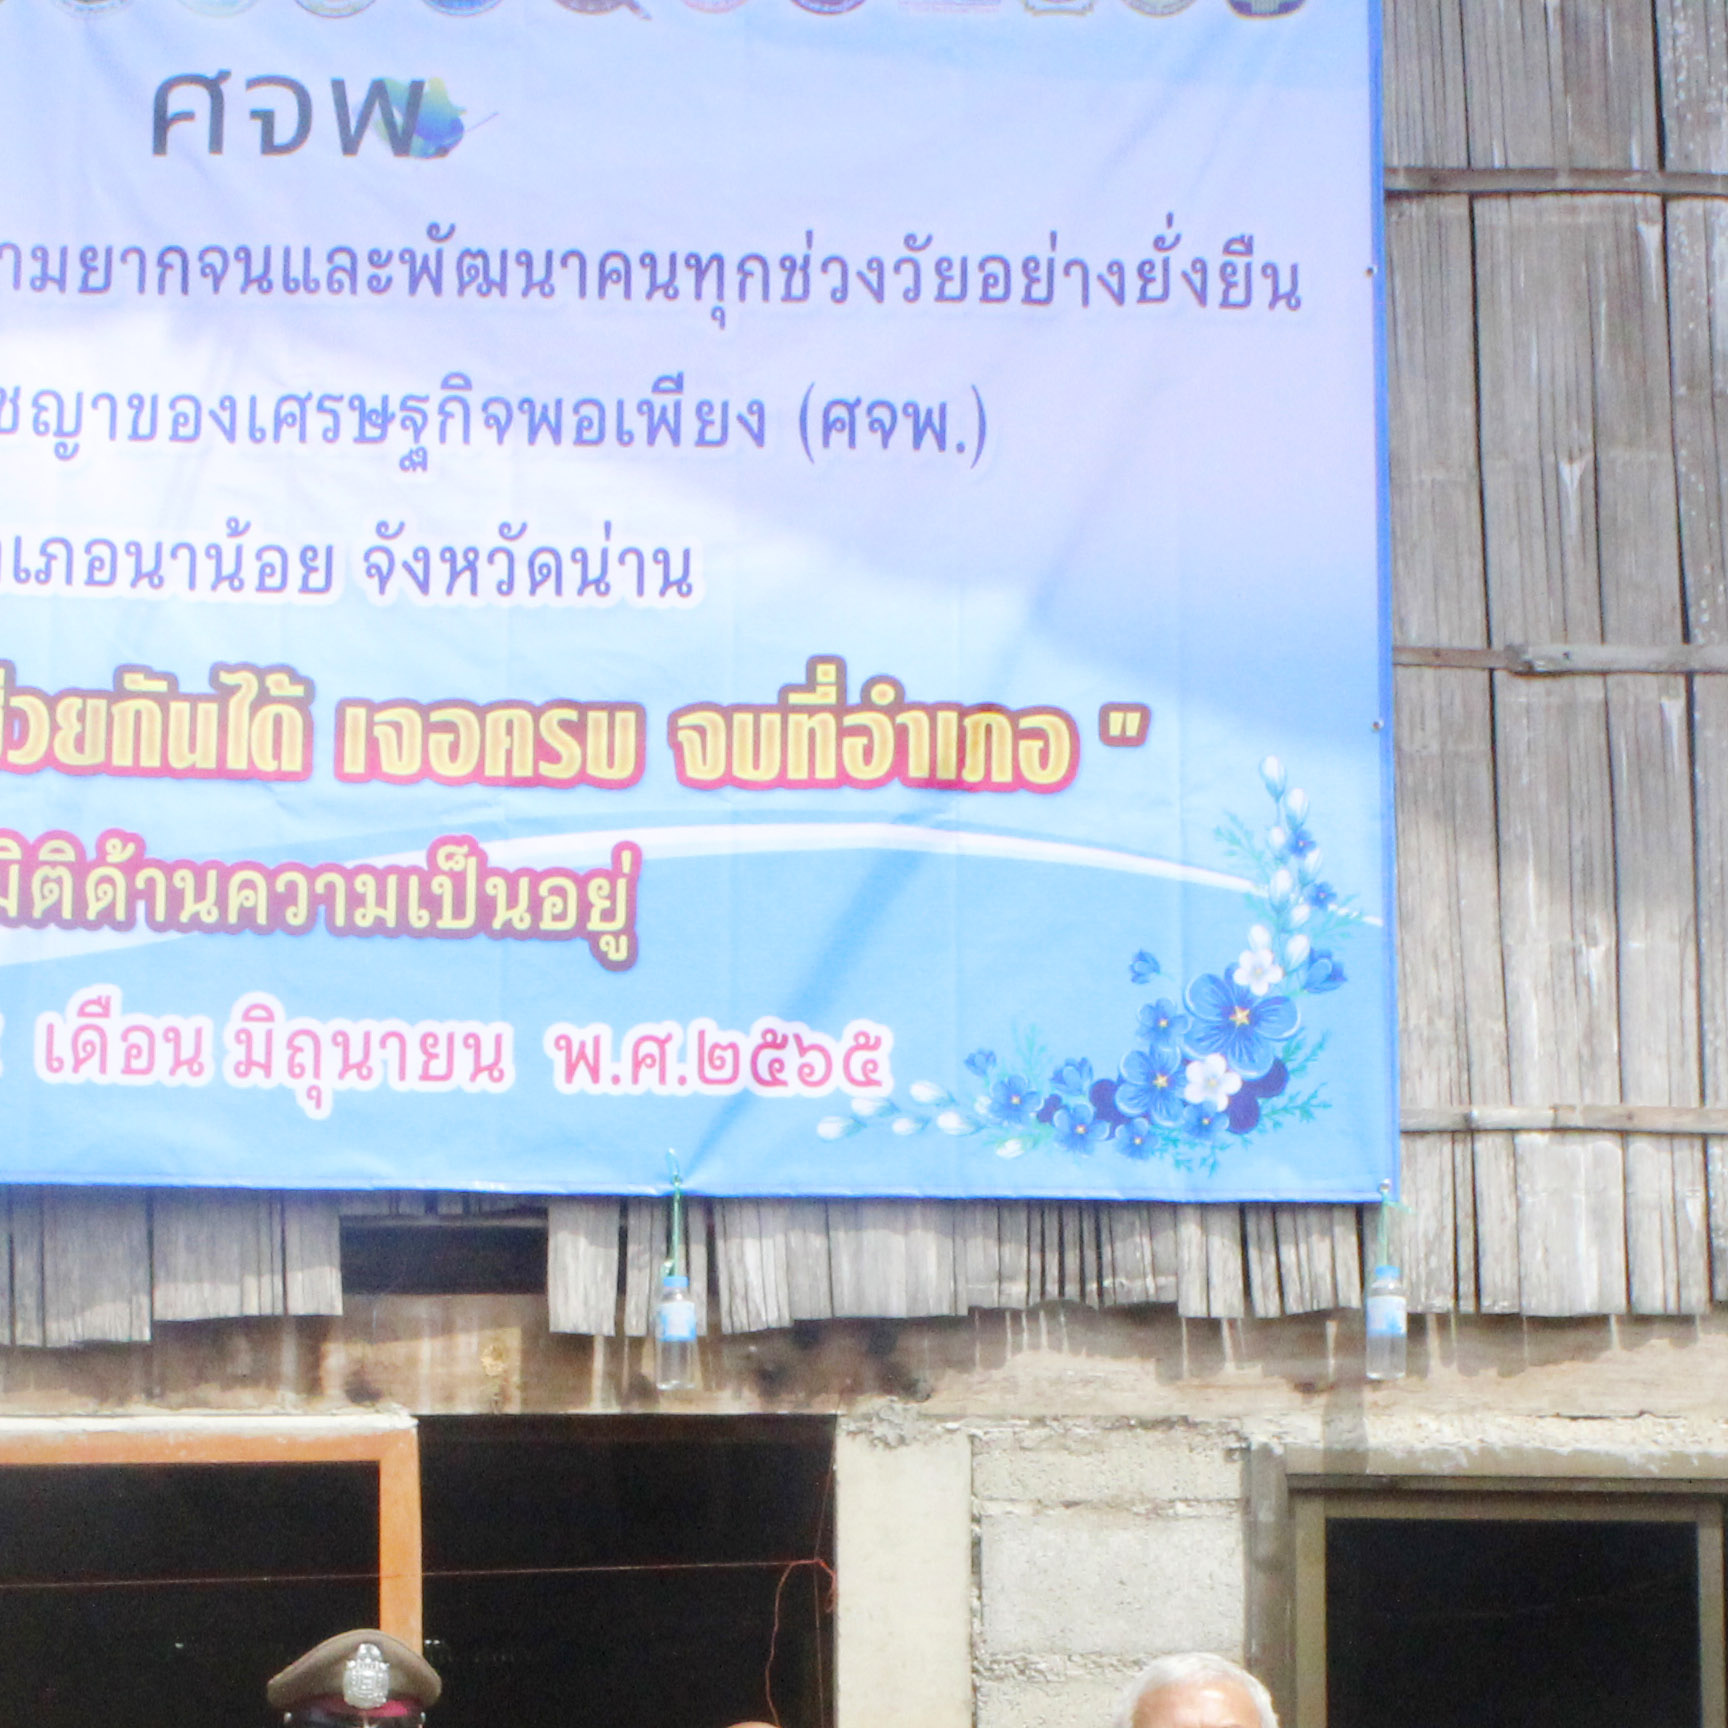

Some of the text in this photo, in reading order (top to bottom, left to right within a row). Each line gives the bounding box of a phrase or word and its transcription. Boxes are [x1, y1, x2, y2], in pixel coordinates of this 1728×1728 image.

[154, 70, 425, 159] ศจพ
[798, 382, 988, 468] (ศจพ.)
[362, 519, 695, 598] จังหวัดน่าน
[342, 705, 639, 780] เจอครบ
[677, 664, 1071, 784] จบที่อำเภอ
[44, 995, 205, 1077] เดือน
[233, 1003, 507, 1110] มิถุนายน
[554, 1027, 887, 1090] พ.ศ.๒๕๖๕
